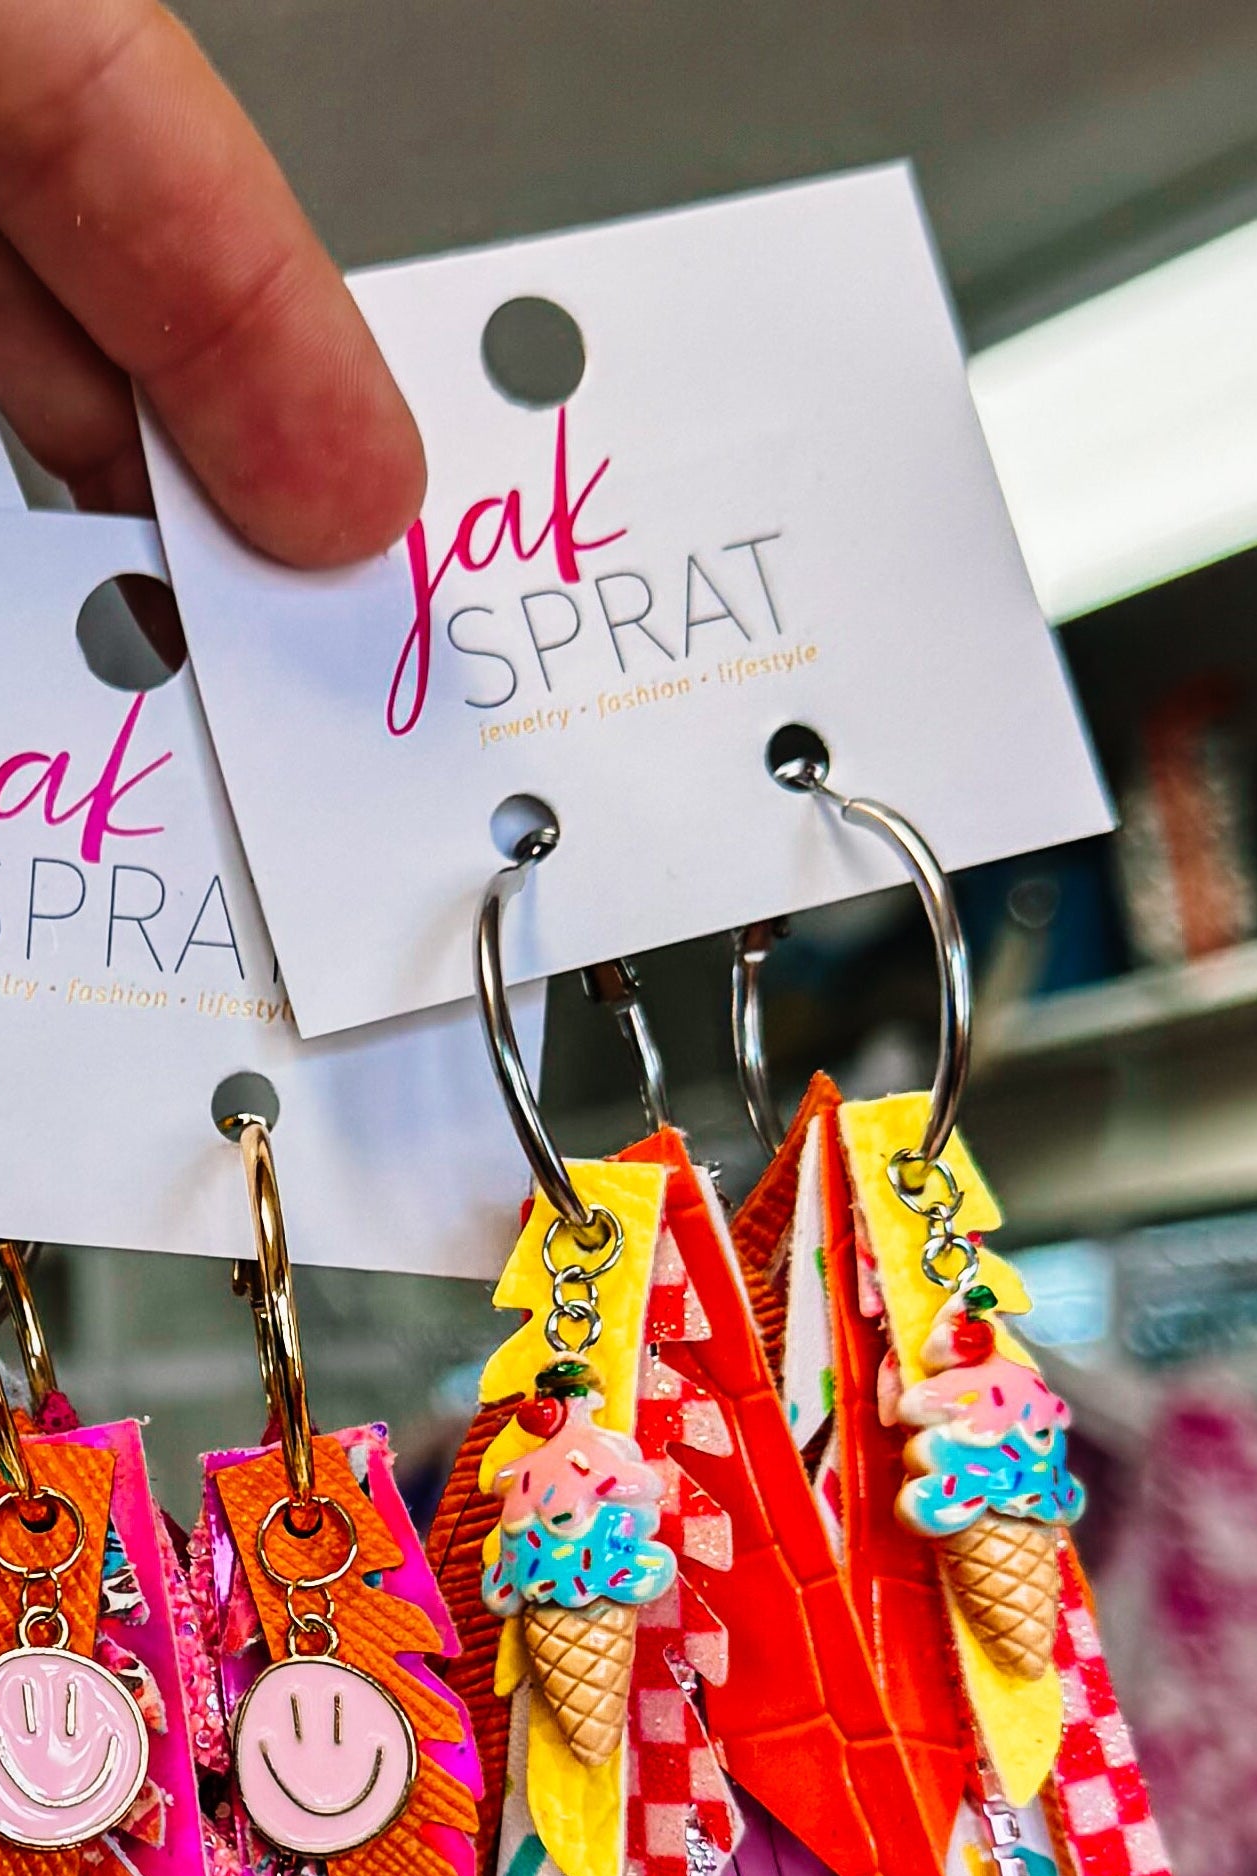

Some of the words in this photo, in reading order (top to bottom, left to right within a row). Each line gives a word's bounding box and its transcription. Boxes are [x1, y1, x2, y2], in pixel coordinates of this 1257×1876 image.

[387, 405, 627, 736] jak
[446, 531, 782, 709] SPRAT
[478, 705, 570, 749] jewelry
[597, 672, 692, 718] fashion
[718, 643, 819, 685] lifestyle
[67, 979, 168, 1008] fashion
